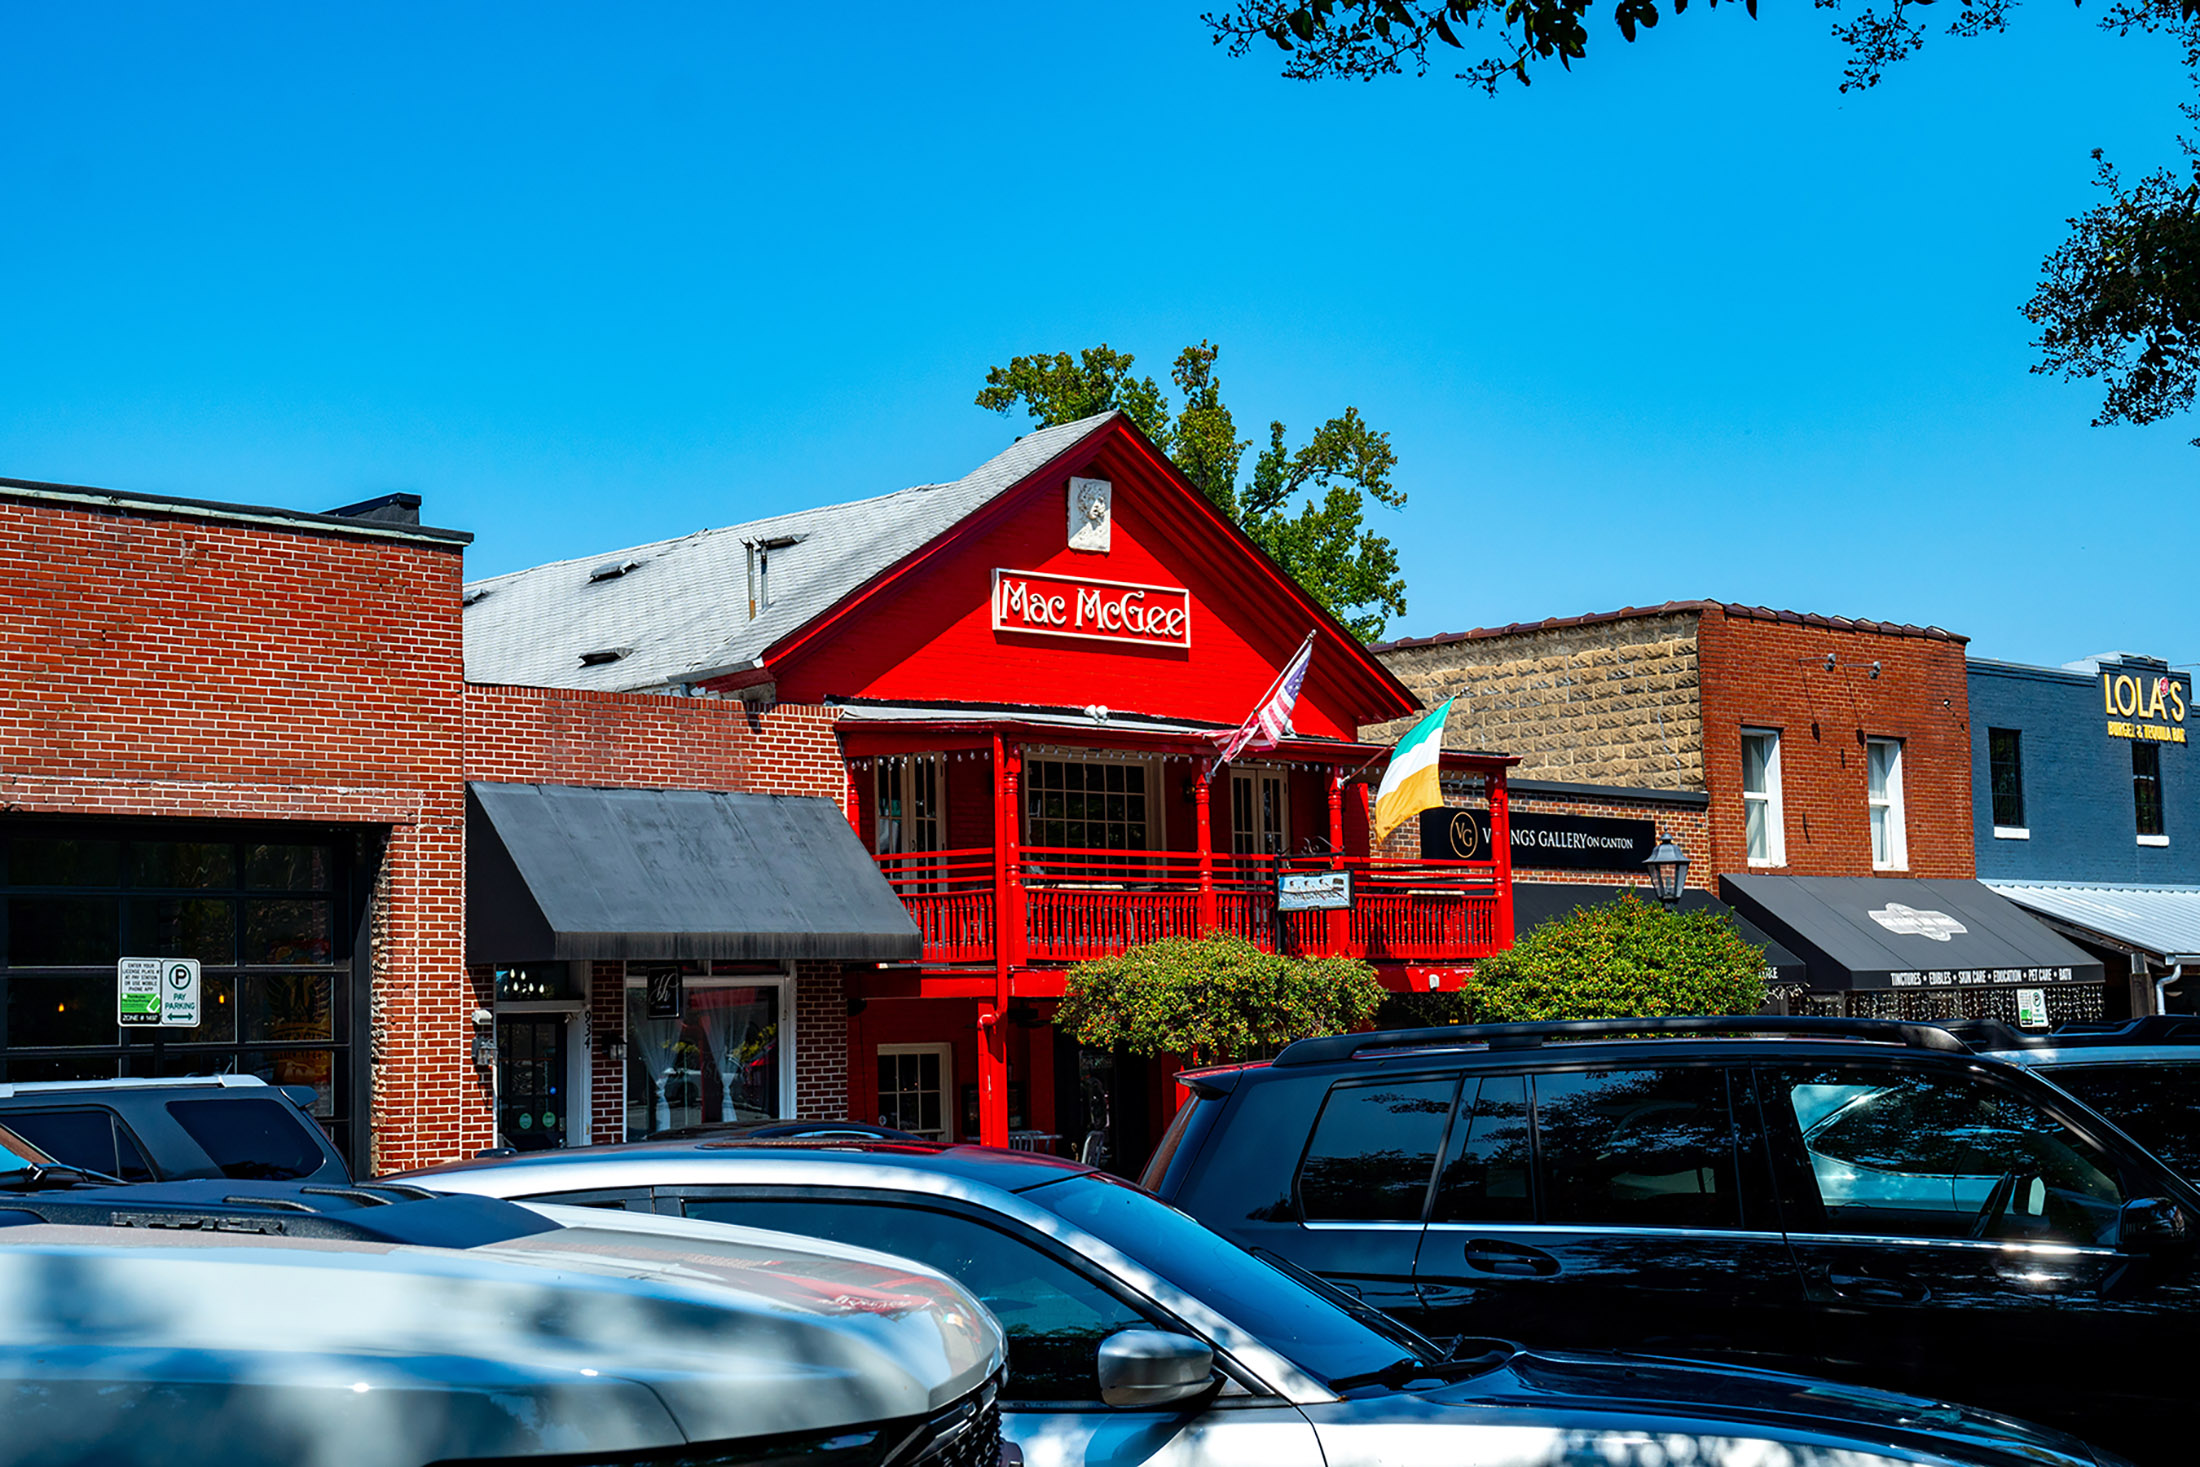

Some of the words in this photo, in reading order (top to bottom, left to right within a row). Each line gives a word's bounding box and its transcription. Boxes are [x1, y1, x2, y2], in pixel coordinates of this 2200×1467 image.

[1000, 580, 1067, 625] Mac
[1075, 588, 1186, 636] McGee
[2104, 673, 2185, 722] LOLA'S
[1482, 827, 1536, 848] VNGS
[1538, 830, 1588, 849] GALLERY
[1587, 836, 1600, 848] ON
[1600, 836, 1633, 849] CANTON
[176, 969, 187, 985] P
[1890, 972, 1922, 986] TINCTURES
[1928, 971, 1952, 986] EDIBLES
[1972, 970, 1987, 984] CARE
[1992, 969, 2023, 983] EDUCATION
[2028, 968, 2037, 981] PET
[2037, 968, 2053, 982] CARE
[165, 1002, 195, 1010] PARKING
[584, 1010, 592, 1049] 934
[111, 1212, 288, 1236] RAPTOR
